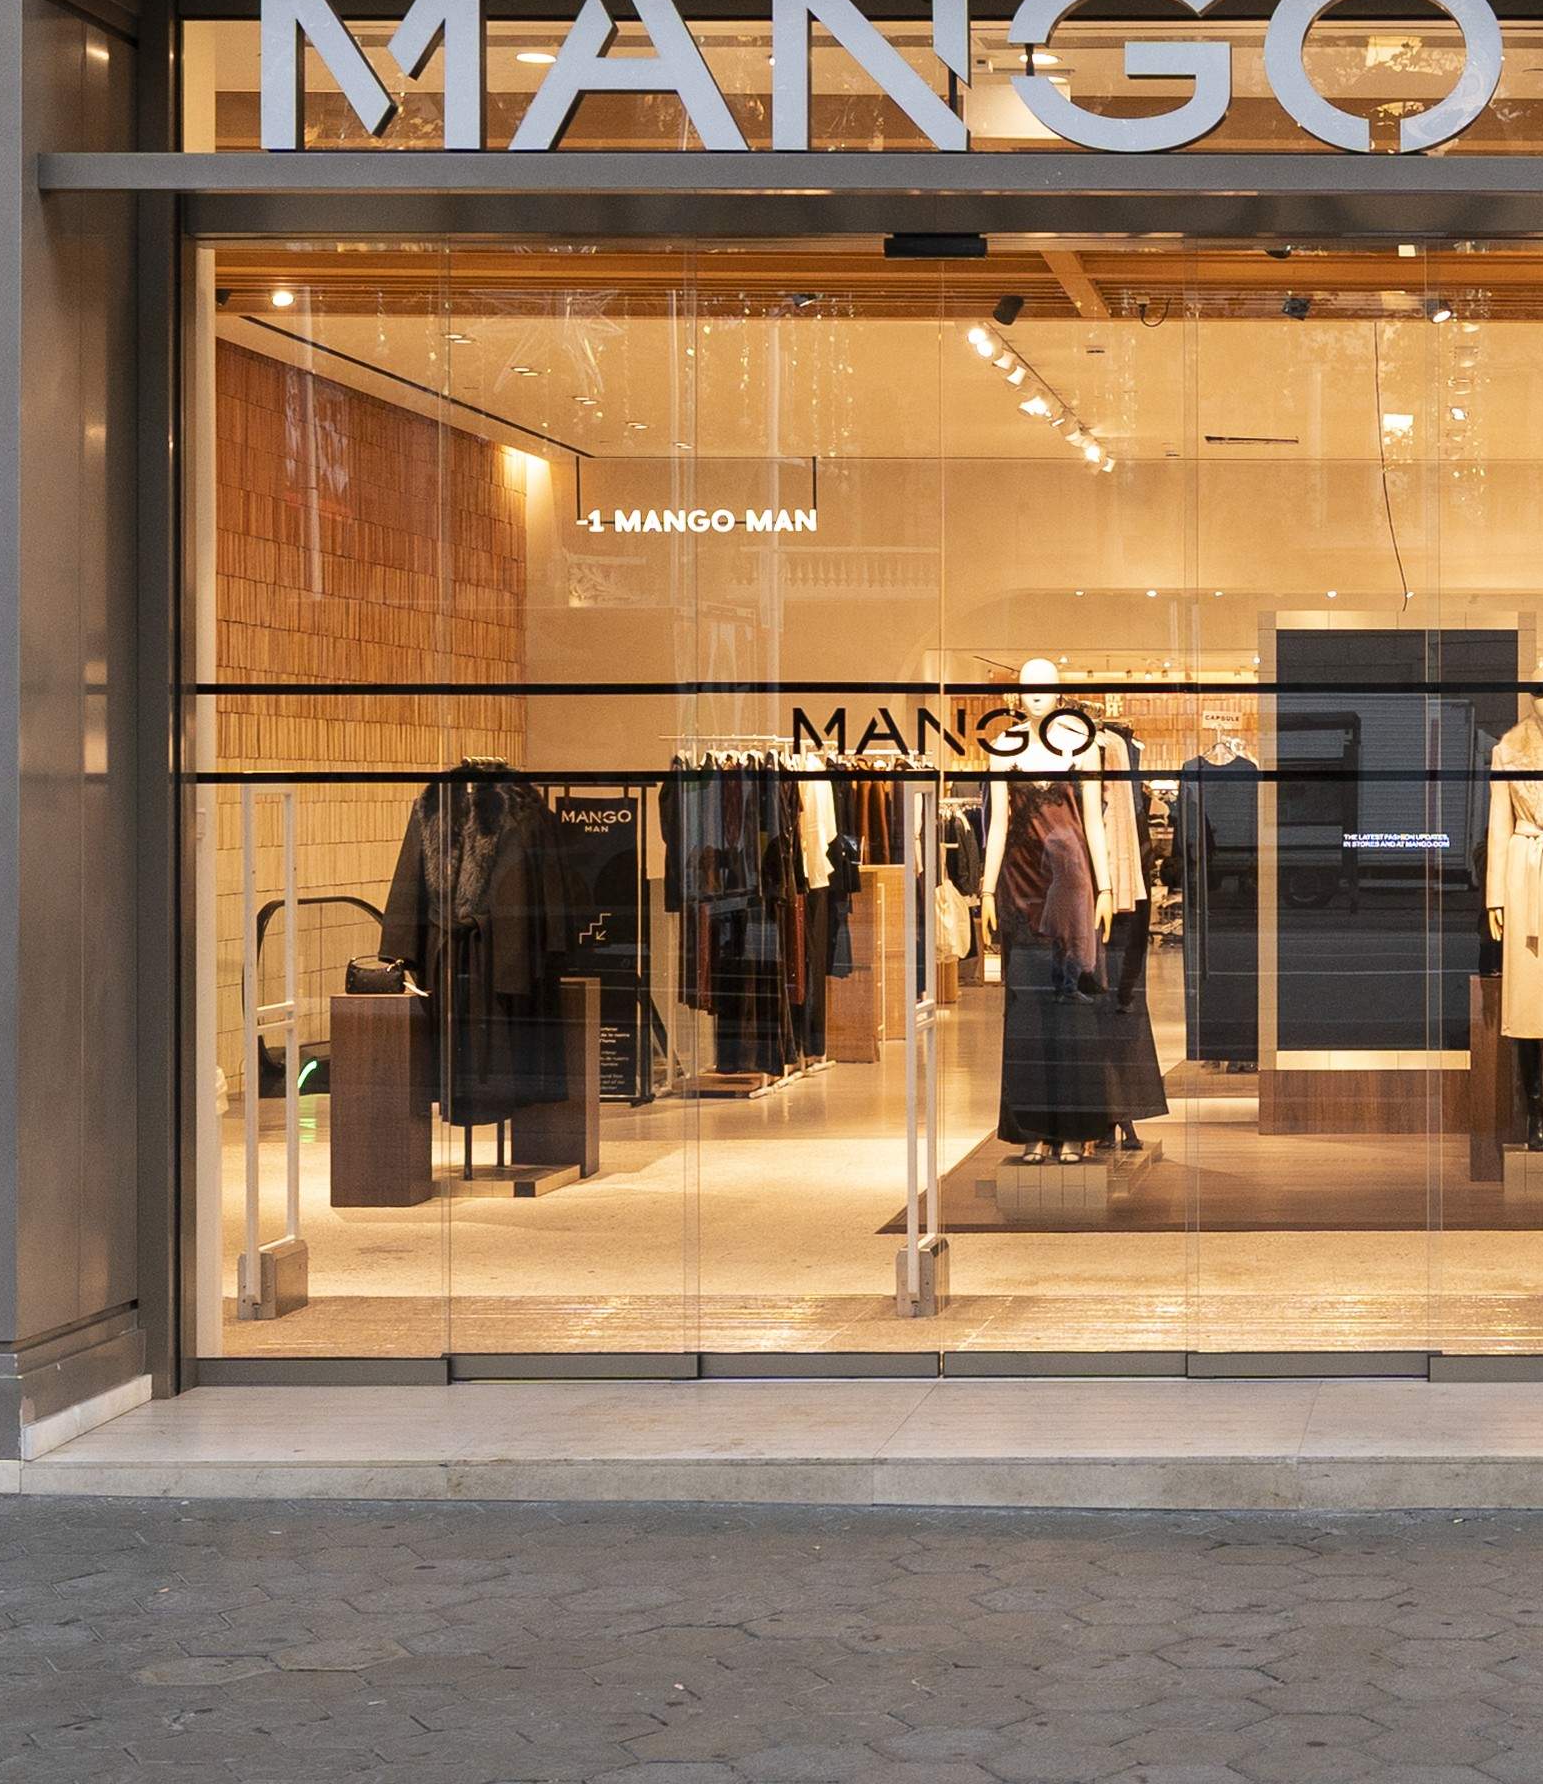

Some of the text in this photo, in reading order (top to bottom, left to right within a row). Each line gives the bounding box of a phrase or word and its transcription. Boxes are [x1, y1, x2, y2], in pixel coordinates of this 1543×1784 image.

[576, 509, 818, 533] -1 MANGO MAN
[792, 707, 1098, 758] MANGO
[560, 809, 633, 825] MANGO
[583, 825, 610, 833] MAN
